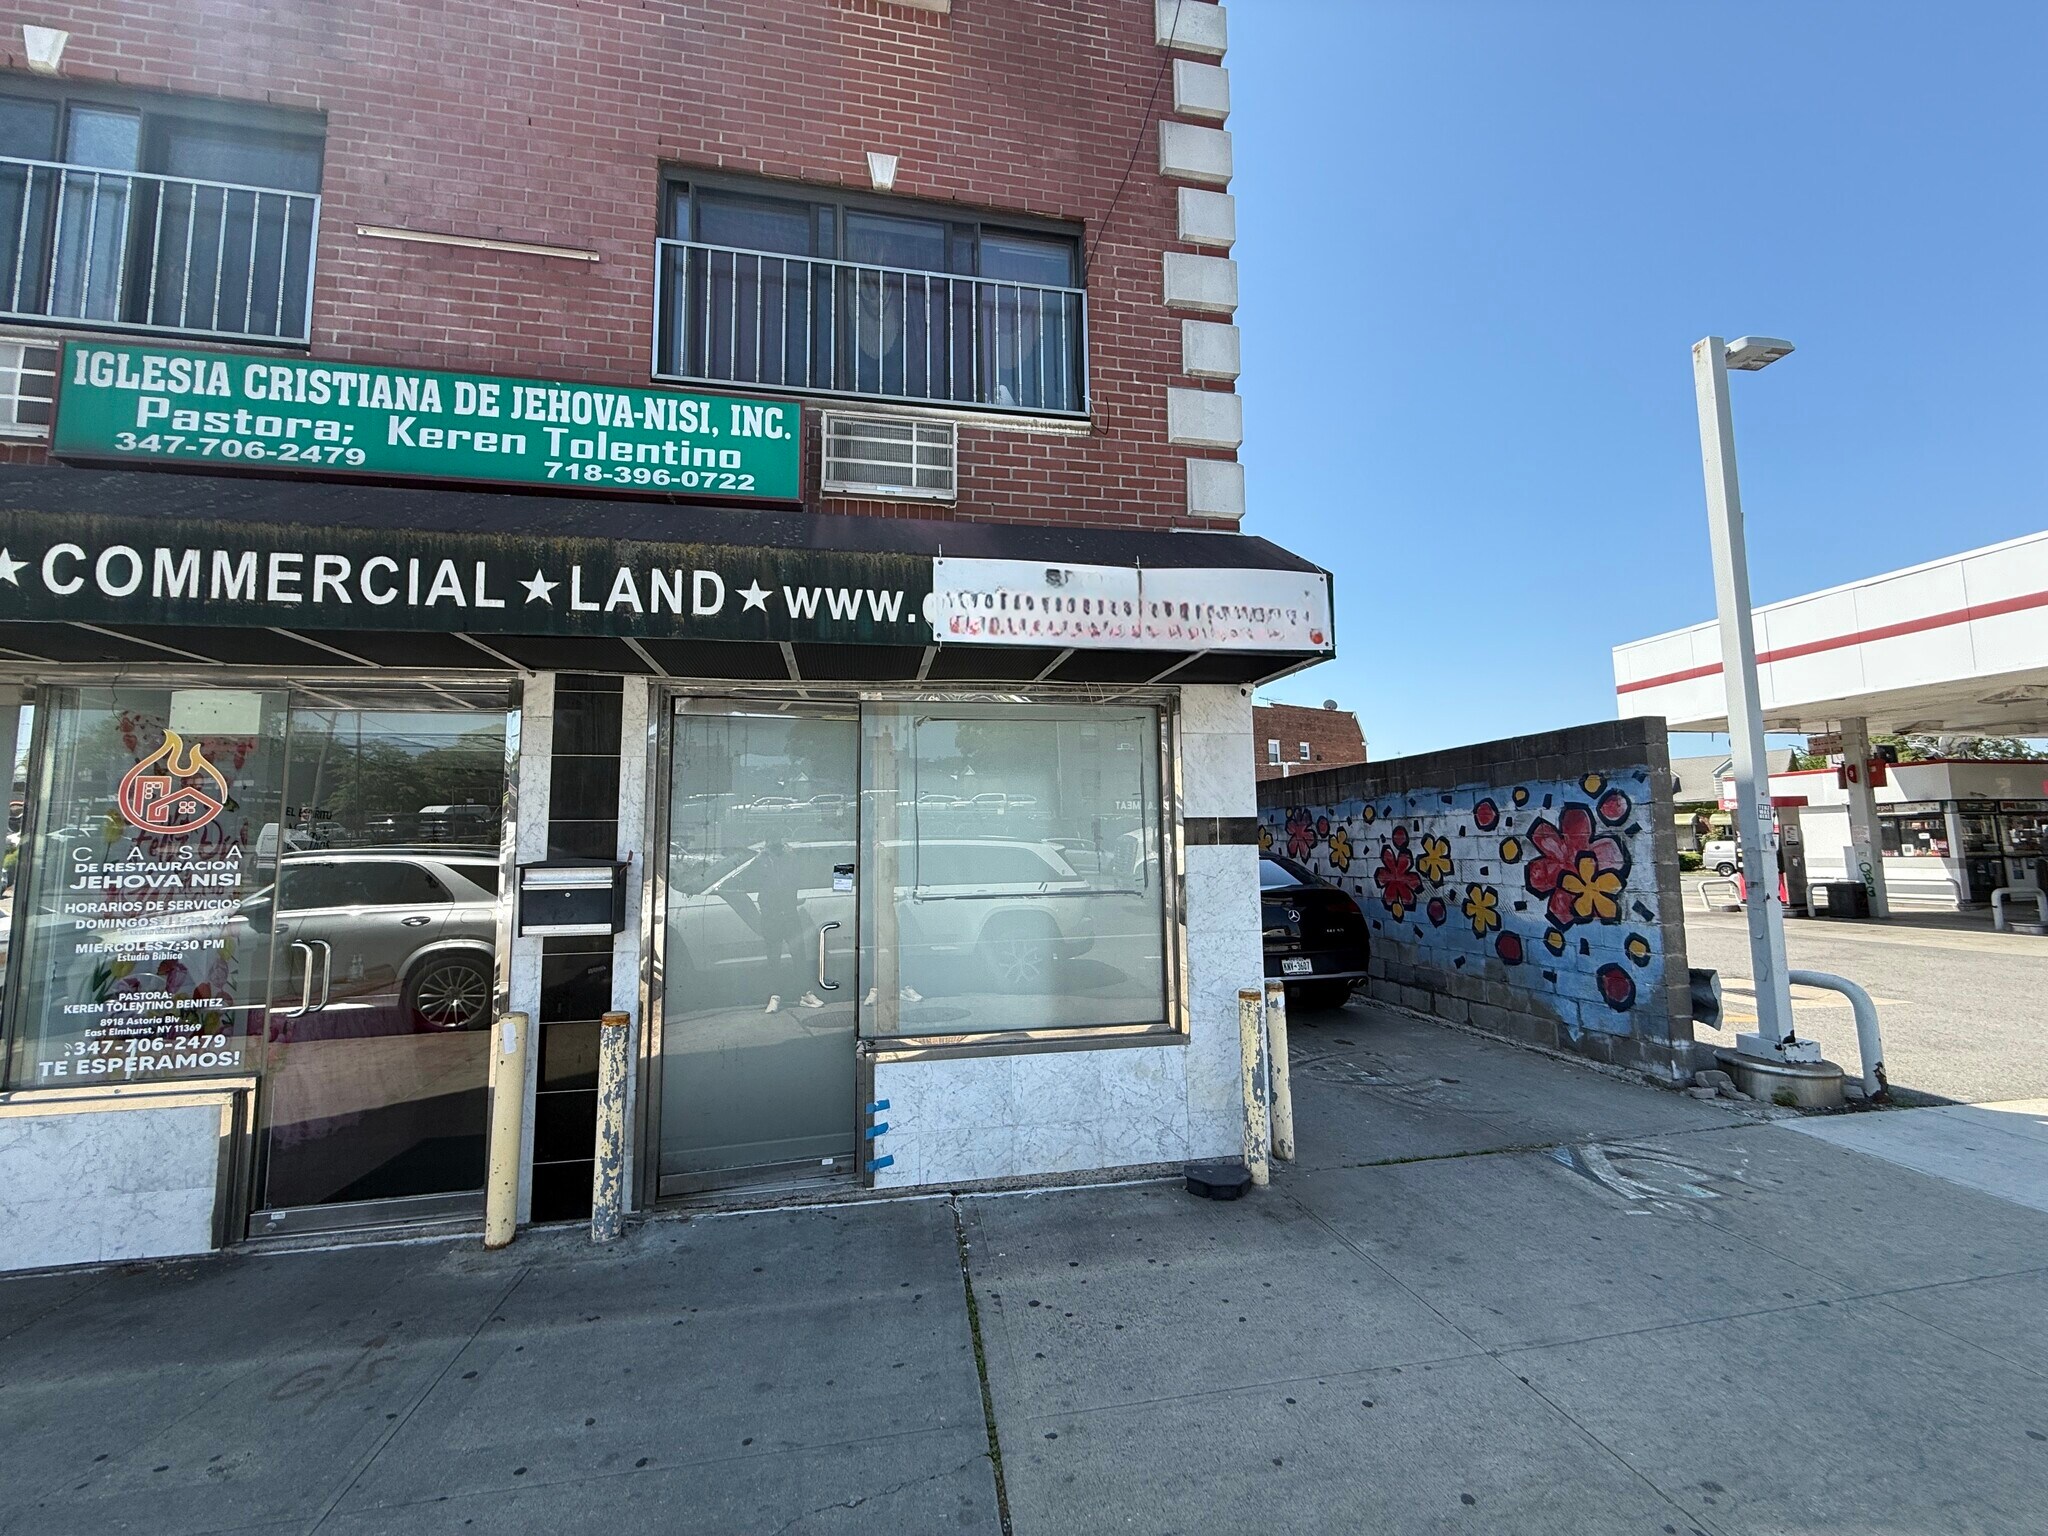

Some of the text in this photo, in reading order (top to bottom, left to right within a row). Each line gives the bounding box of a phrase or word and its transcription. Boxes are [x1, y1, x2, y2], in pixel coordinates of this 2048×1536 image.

[73, 350, 792, 440] IGLESIA CRISTIANA DE JEHOVA-NISI, INC.
[114, 432, 366, 466] 347-706-2479
[388, 415, 527, 455] Keren
[543, 427, 742, 469] Tolentino
[544, 461, 755, 491] 718-396-0722
[41, 543, 506, 608] COMMERCIAL
[571, 565, 726, 615] LAND
[75, 861, 239, 873] DE RESTAURACION
[69, 874, 184, 890] JEHOVA
[191, 873, 242, 887] NISI
[65, 899, 242, 914] HORARIOS DE SERVICIOS
[75, 917, 159, 930] DOMINGOS
[75, 939, 225, 954] MIERCOLES 7:30 PM
[117, 953, 150, 962] Estudio
[118, 991, 172, 1001] PASTORA:
[63, 998, 223, 1014] KEREN TOLENTINO BENITEZ
[100, 1017, 124, 1026] 8918
[126, 1016, 163, 1025] Astoria
[84, 1023, 202, 1037] East Elmhurst, NY 11369
[74, 1034, 226, 1056] 347-706-2479
[39, 1051, 241, 1077] TE ESPERAMOS!
